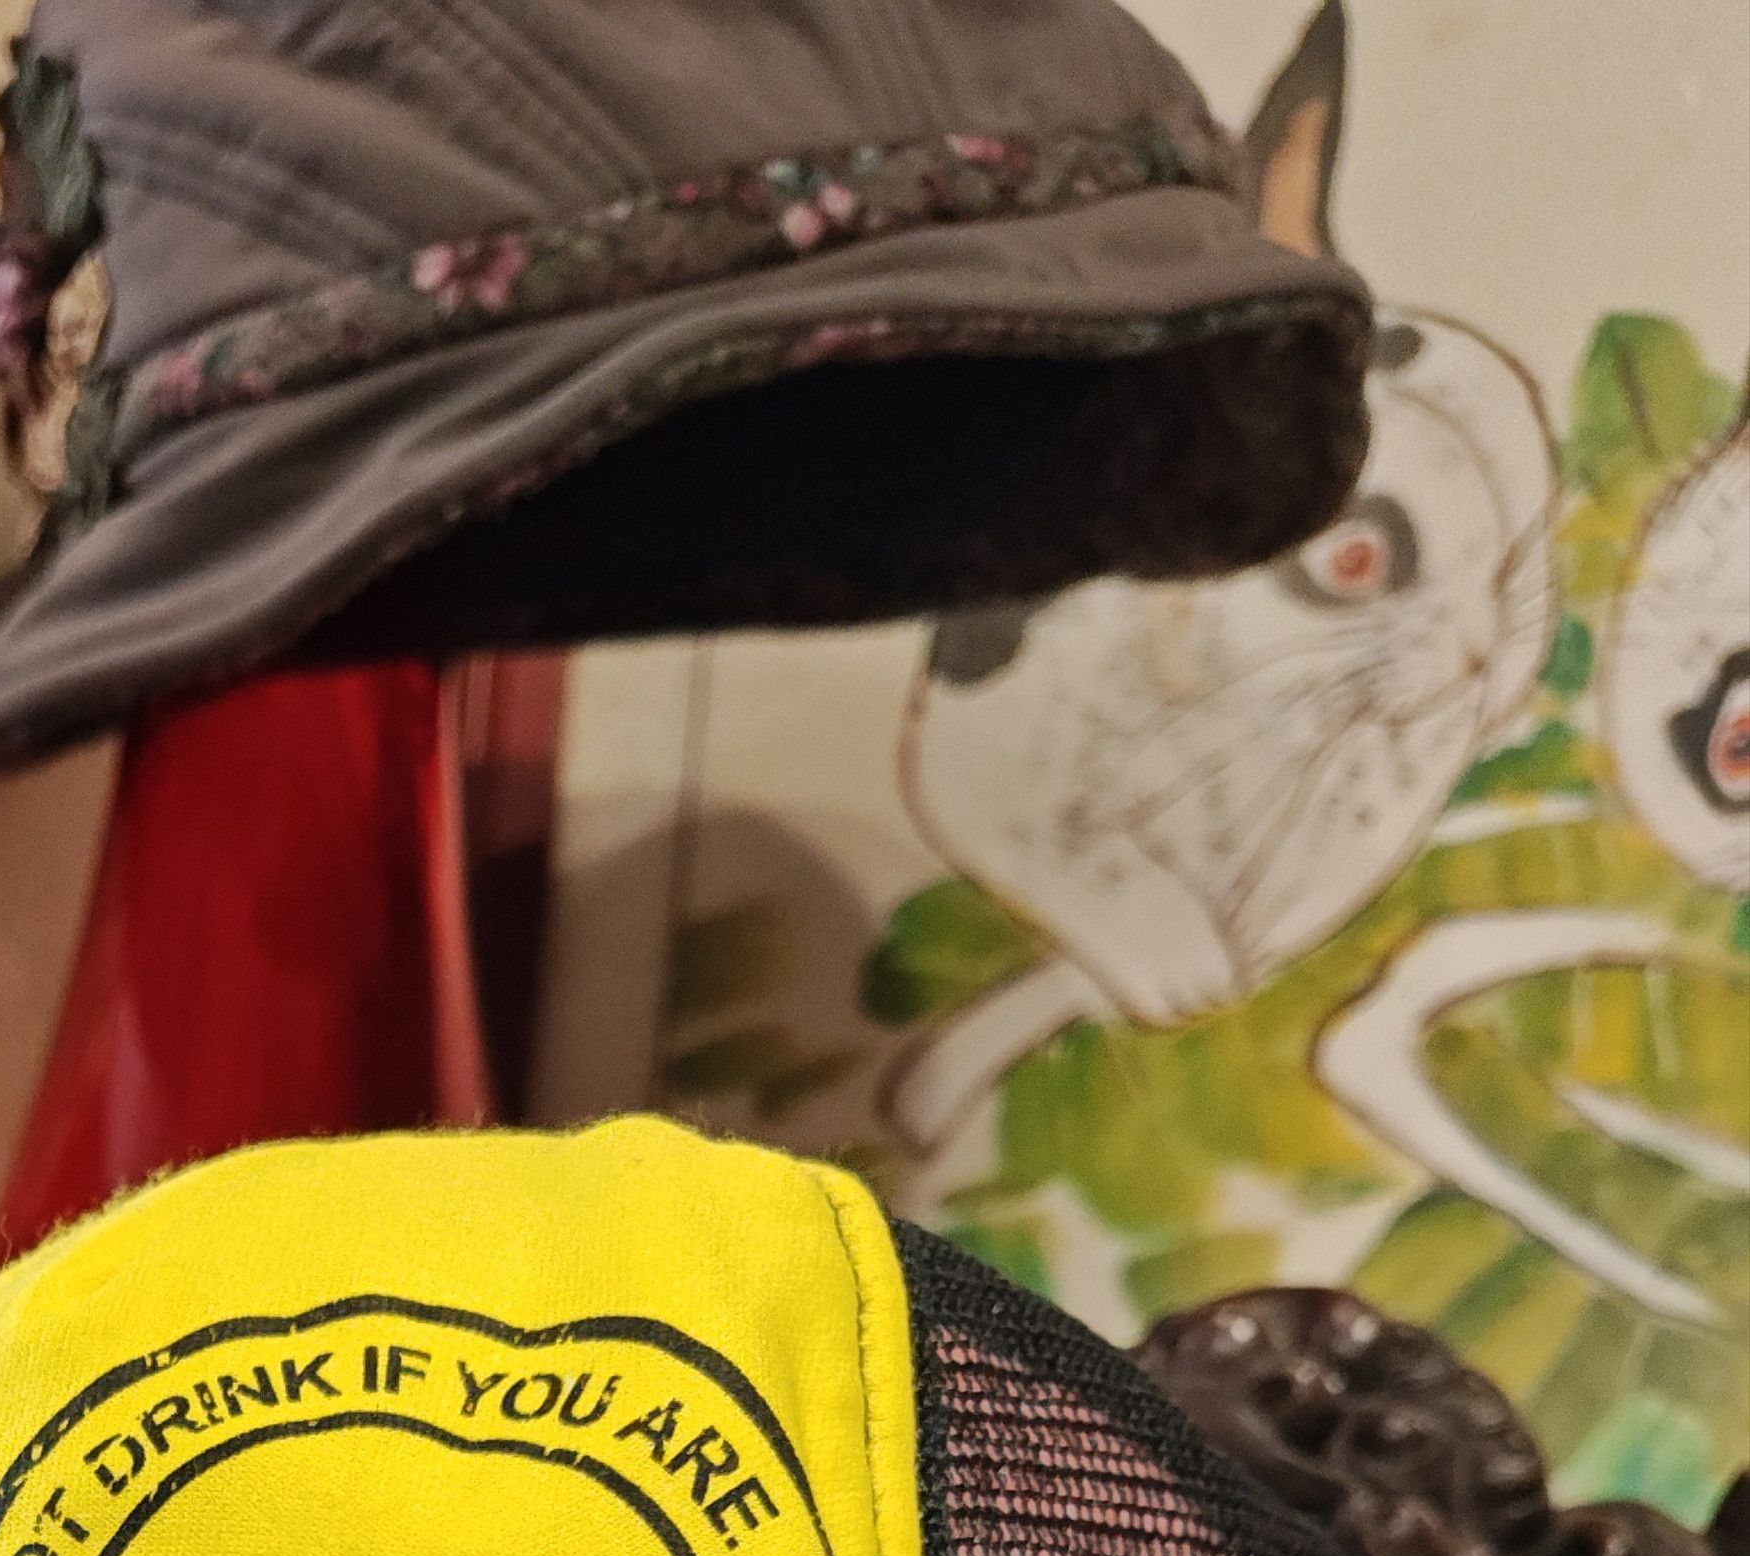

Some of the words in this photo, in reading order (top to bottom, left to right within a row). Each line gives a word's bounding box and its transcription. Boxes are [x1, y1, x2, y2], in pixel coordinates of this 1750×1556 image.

[83, 1351, 340, 1497] DRINK
[362, 1343, 432, 1394] IF
[455, 1360, 621, 1428] YOU
